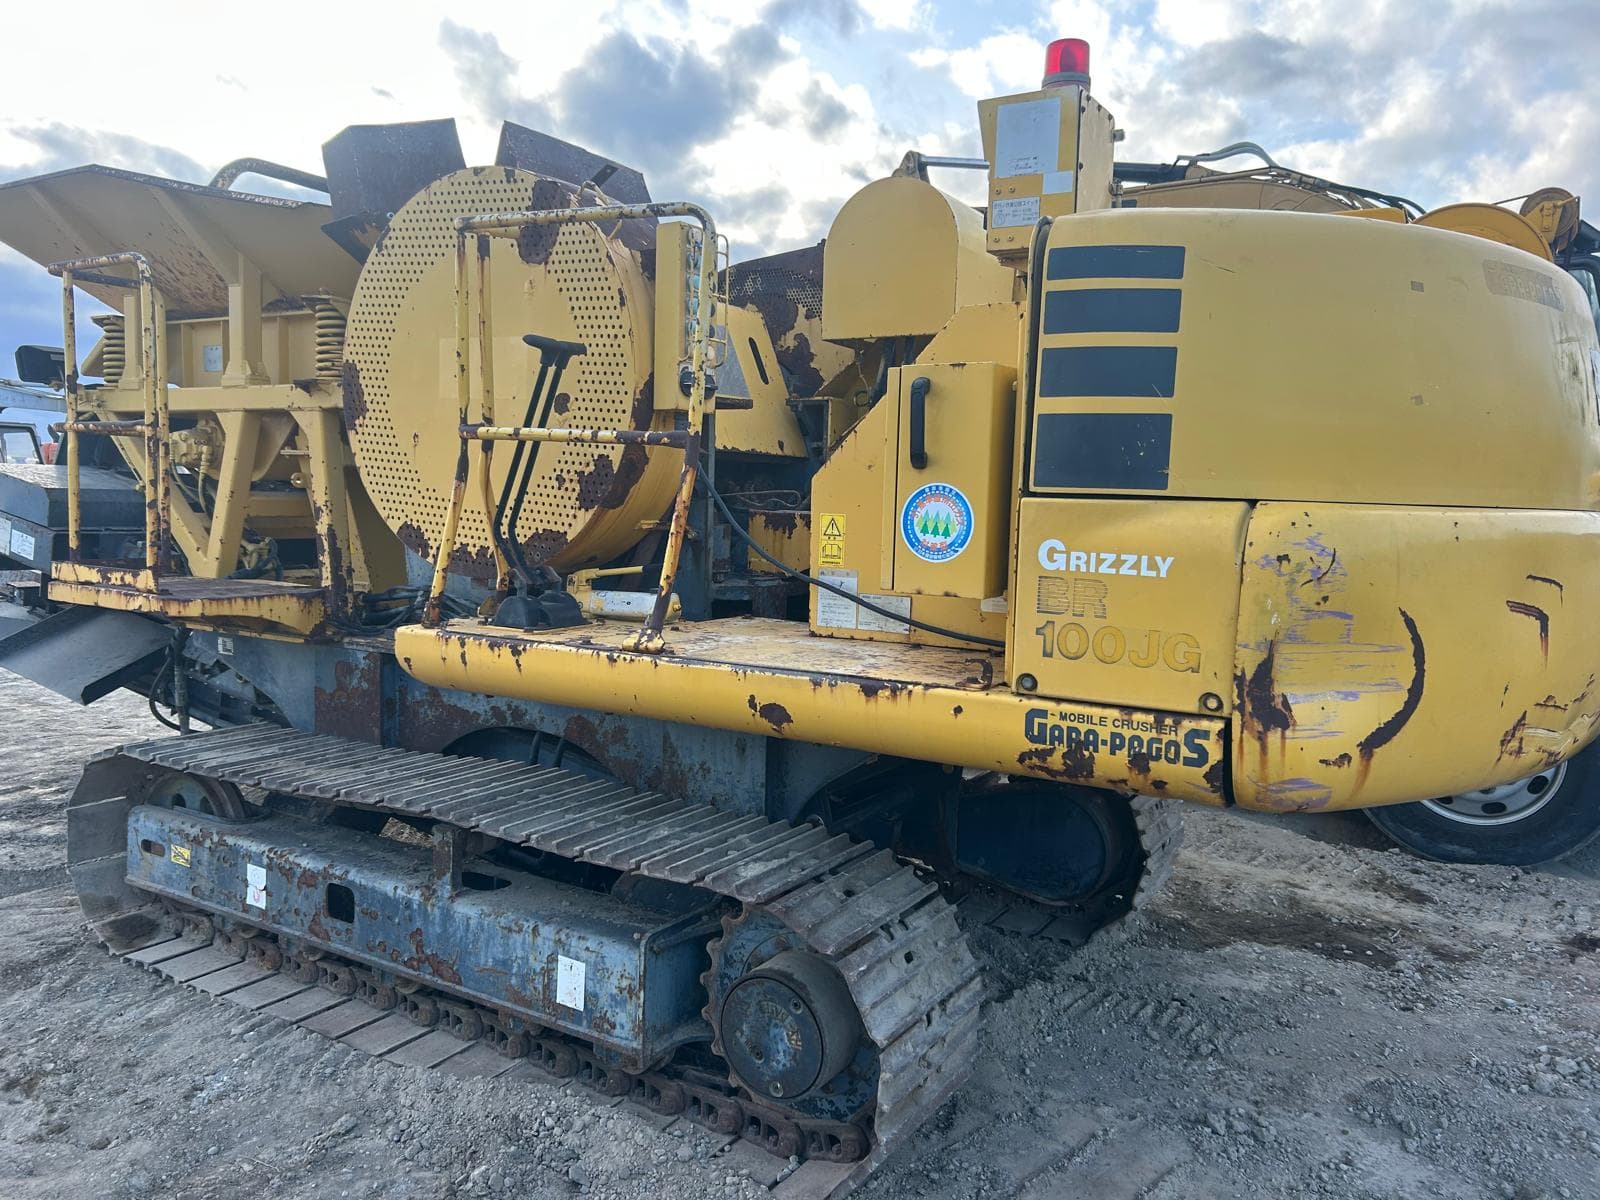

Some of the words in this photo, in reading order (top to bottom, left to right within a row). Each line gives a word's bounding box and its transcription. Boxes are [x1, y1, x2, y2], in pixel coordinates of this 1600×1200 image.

[1037, 538, 1175, 578] GRIZZLY
[1036, 575, 1109, 620] BR
[1035, 620, 1202, 674] 100JG
[1058, 711, 1108, 727] MOBILE
[1112, 718, 1178, 737] CRUSHER
